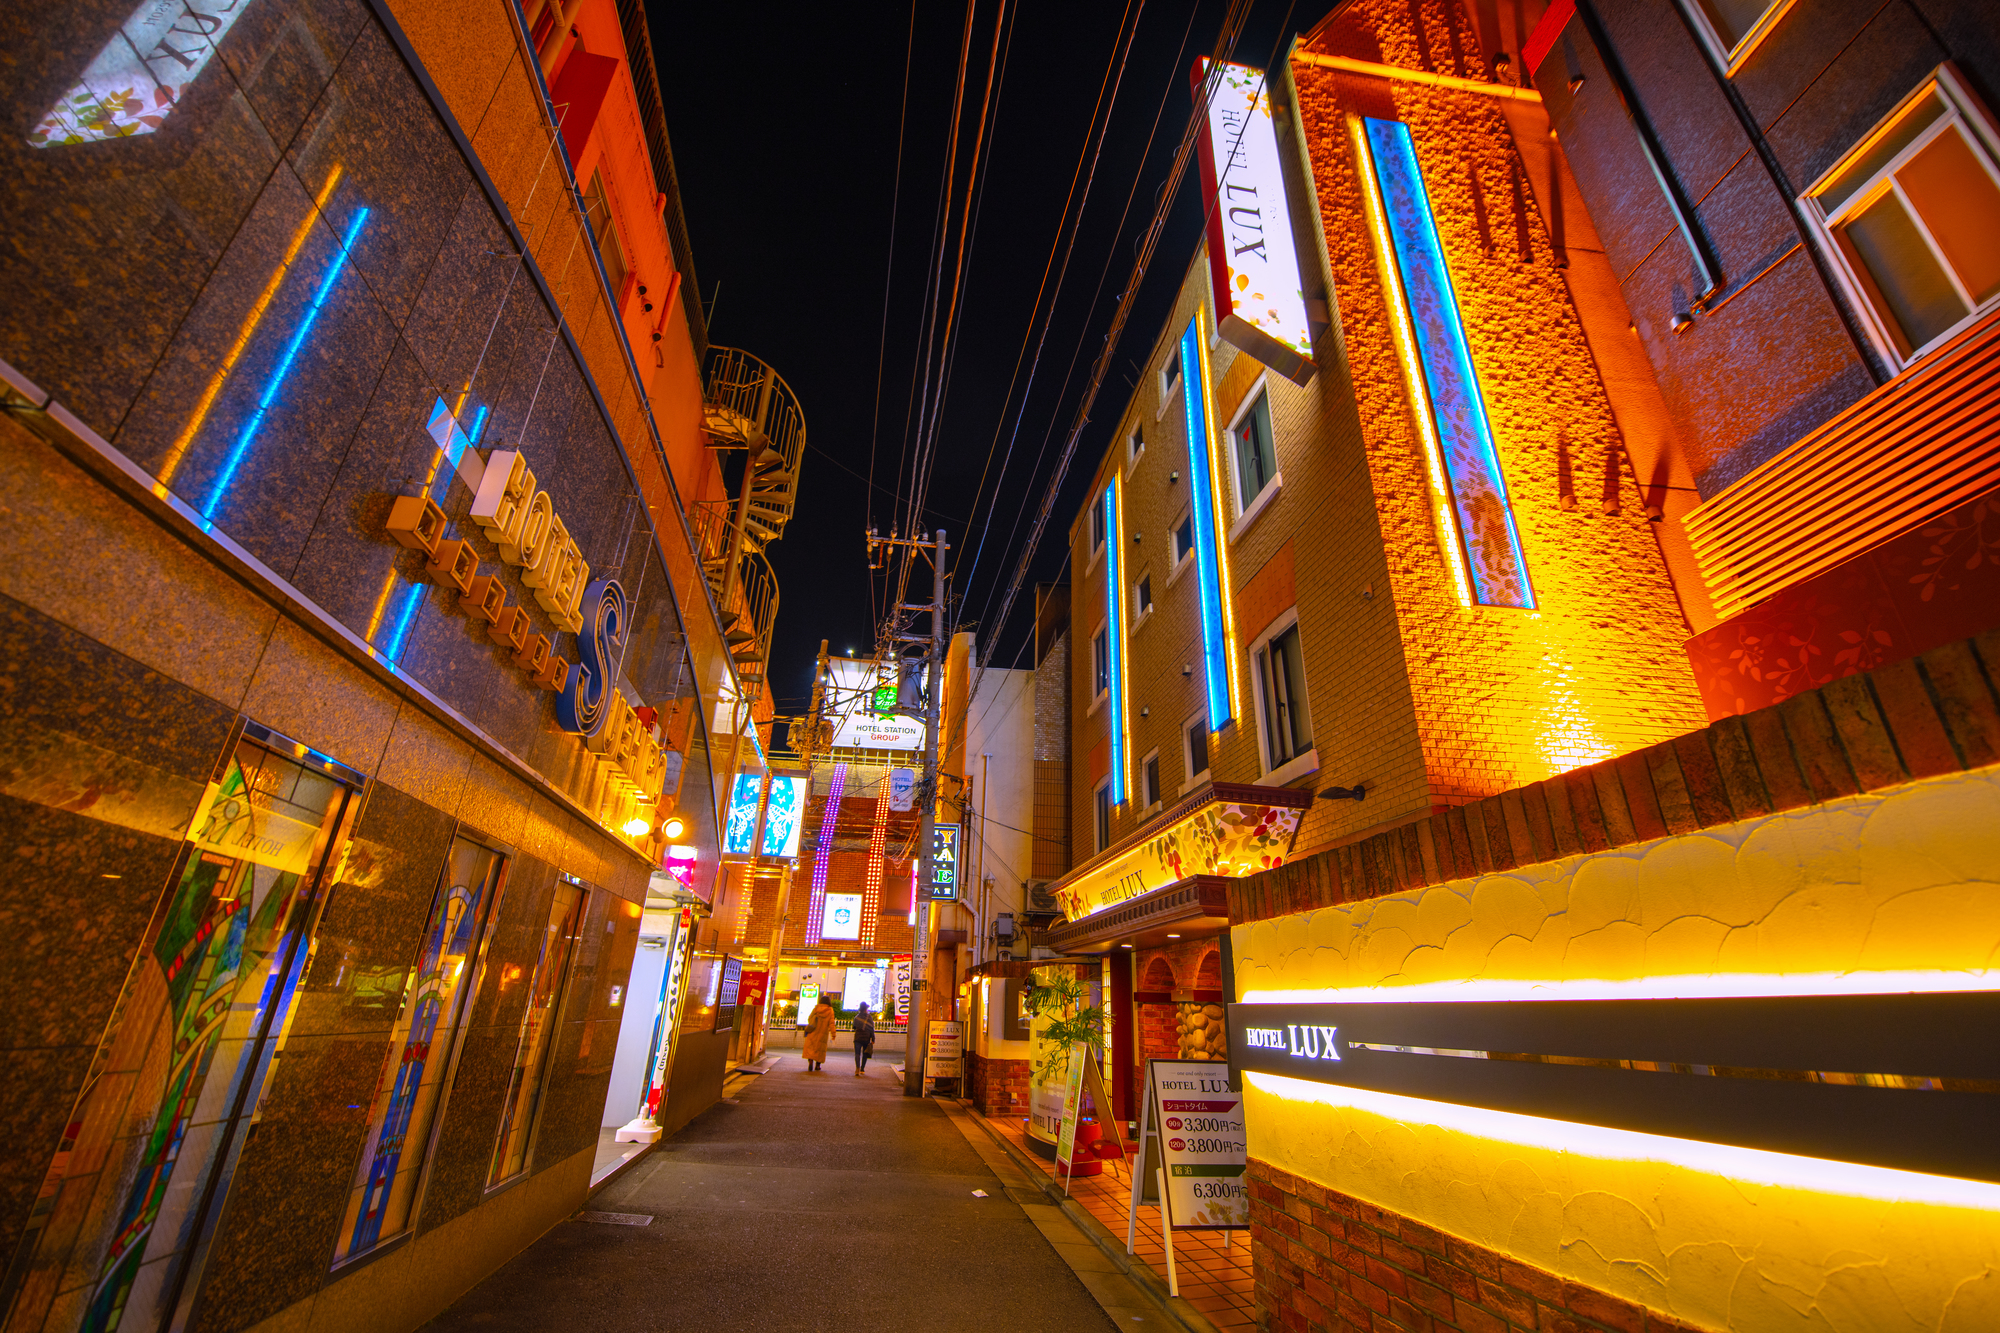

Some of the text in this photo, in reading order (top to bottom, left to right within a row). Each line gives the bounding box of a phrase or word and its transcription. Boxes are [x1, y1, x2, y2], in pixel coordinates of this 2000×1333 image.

[1221, 108, 1268, 264] HOTEL LUX
[472, 449, 590, 636] HOTEL
[856, 724, 917, 735] HOTEL STATION
[870, 733, 900, 742] GROUP
[895, 782, 909, 792] ivy
[1100, 869, 1148, 906] HOTEL LUX
[898, 962, 911, 1015] ¥3,500
[1246, 1024, 1341, 1061] HOTEL LUX
[1161, 1079, 1237, 1093] HOTEL LUX
[1166, 1101, 1208, 1111] ショートタイム
[1047, 1115, 1062, 1136] LU
[1174, 1165, 1193, 1175] 宿泊
